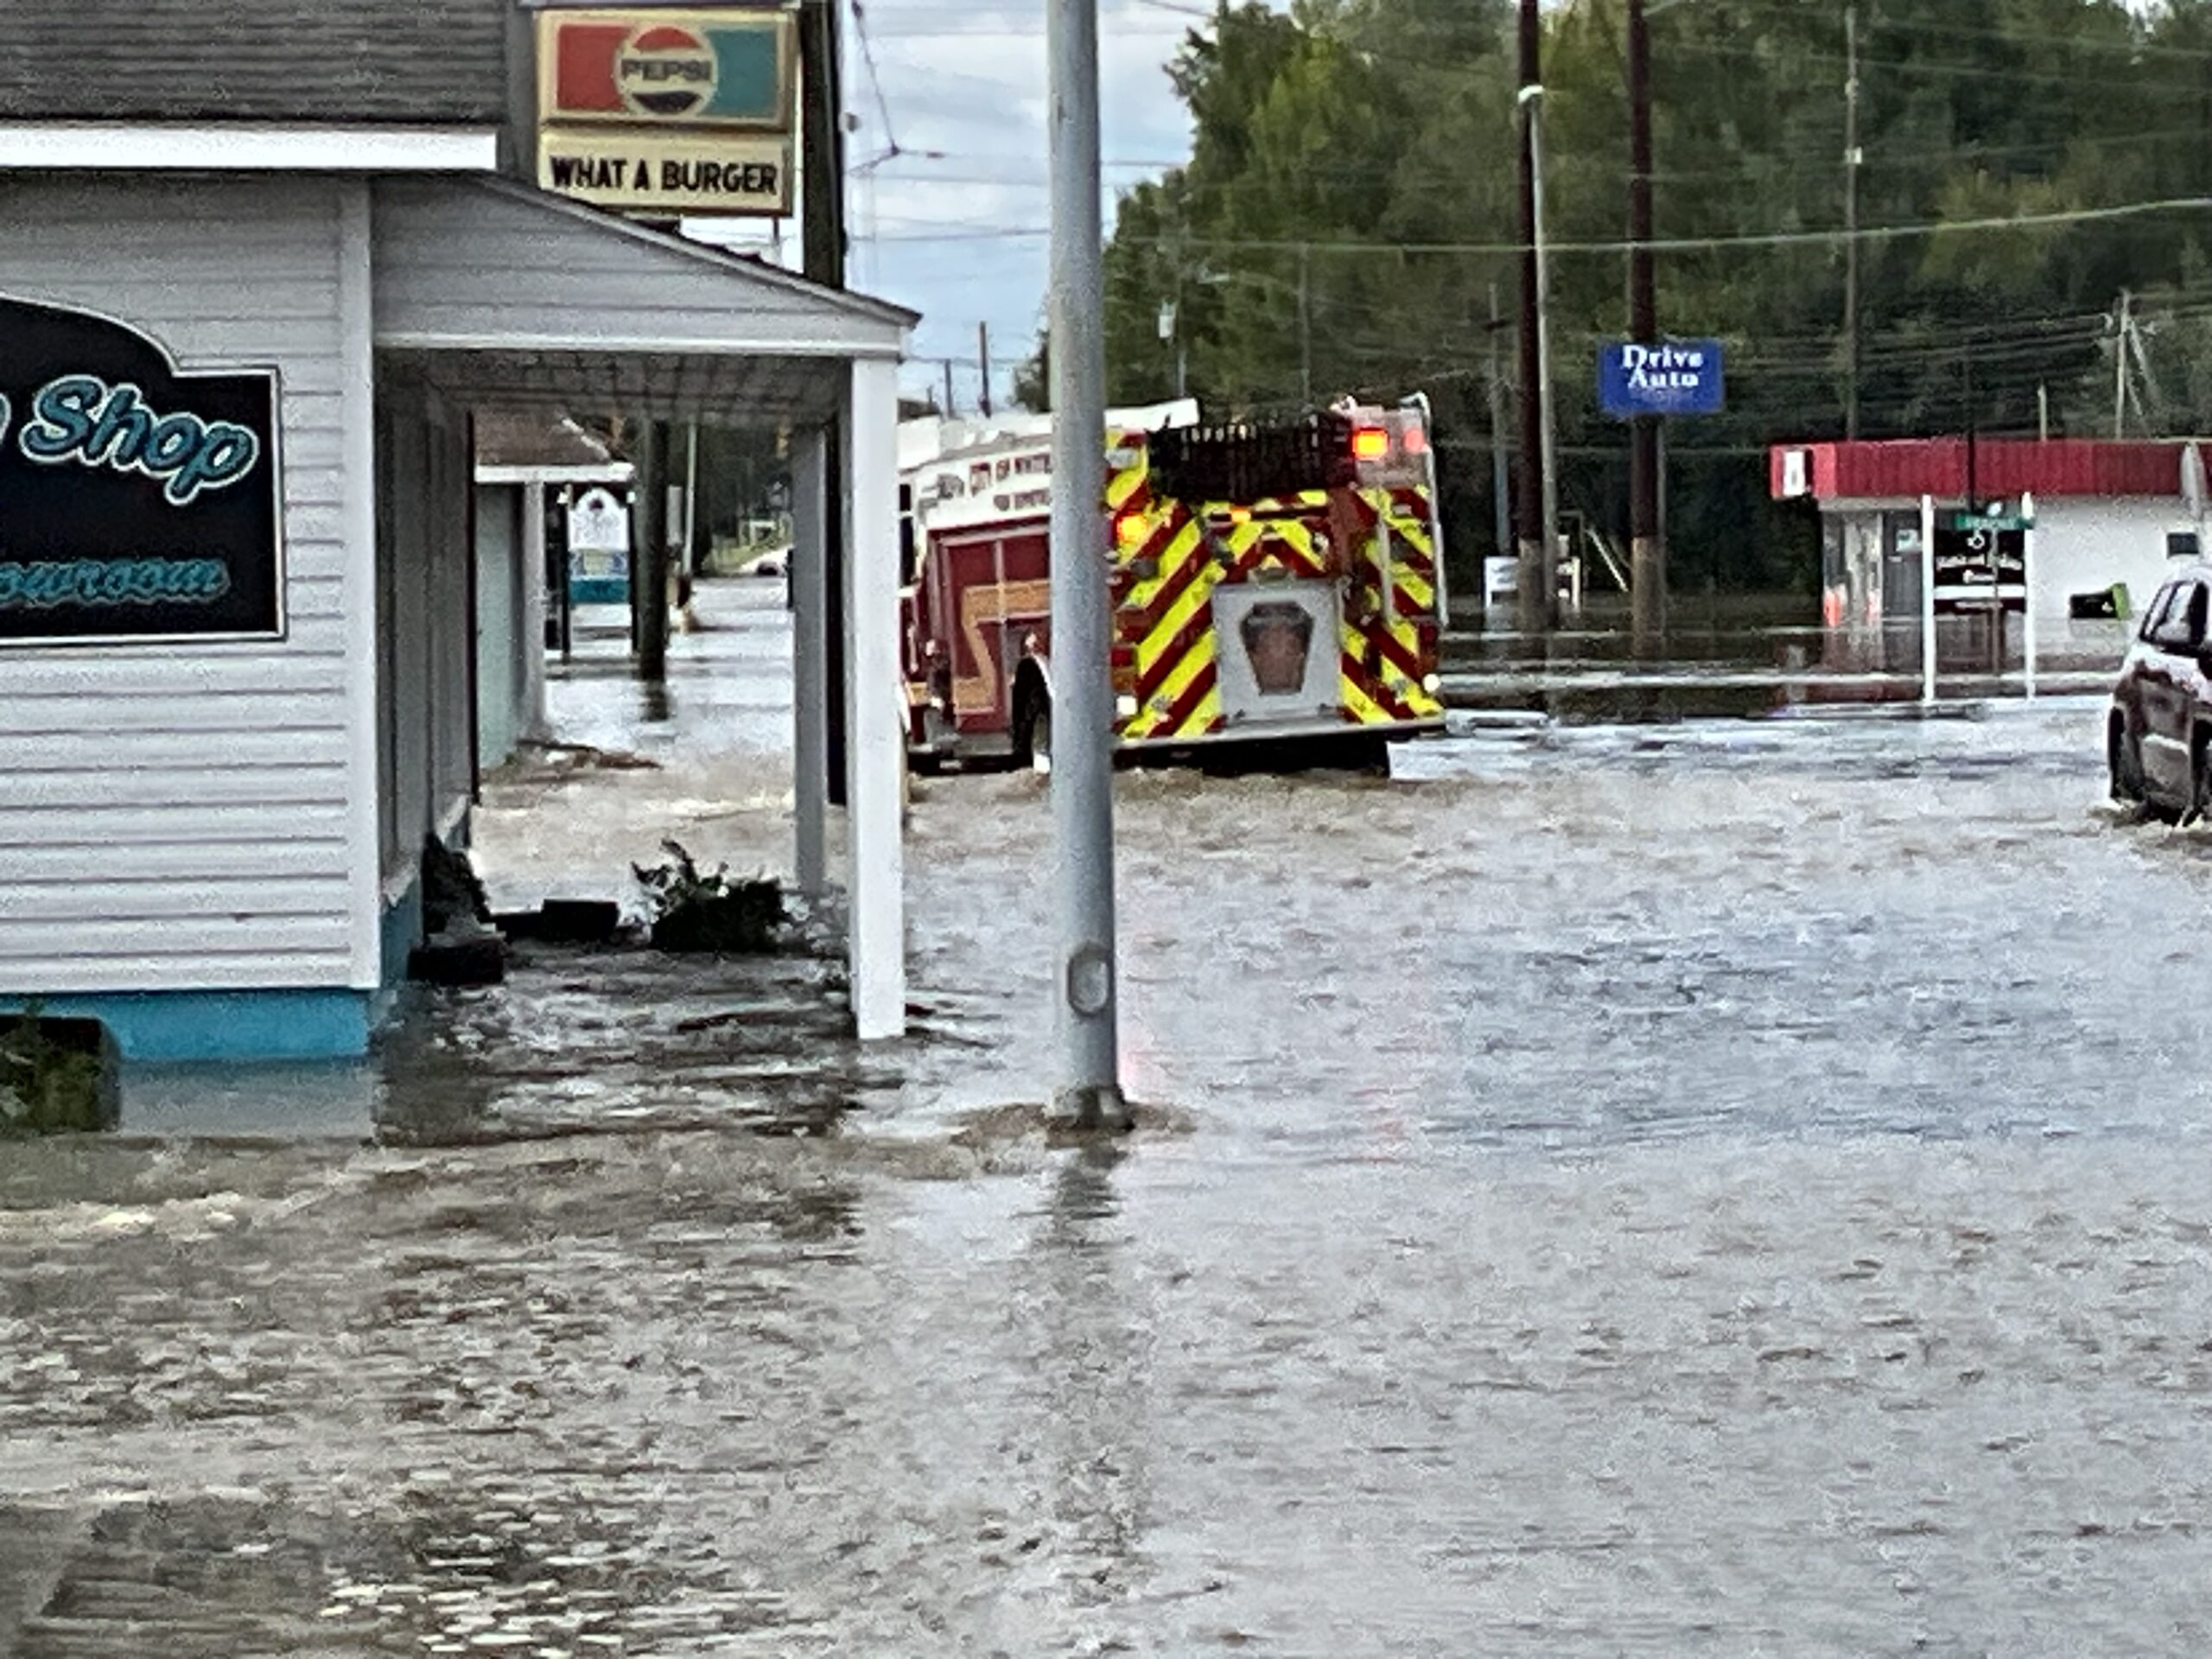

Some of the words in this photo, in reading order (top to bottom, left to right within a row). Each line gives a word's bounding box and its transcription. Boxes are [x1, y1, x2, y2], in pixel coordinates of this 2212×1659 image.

[620, 58, 711, 80] PEPSI
[550, 156, 626, 188] WHAT
[633, 159, 651, 190] A
[661, 161, 777, 194] BURGER
[1622, 344, 1703, 367] Drive
[1628, 366, 1699, 389] Auto
[19, 374, 258, 506] Shop
